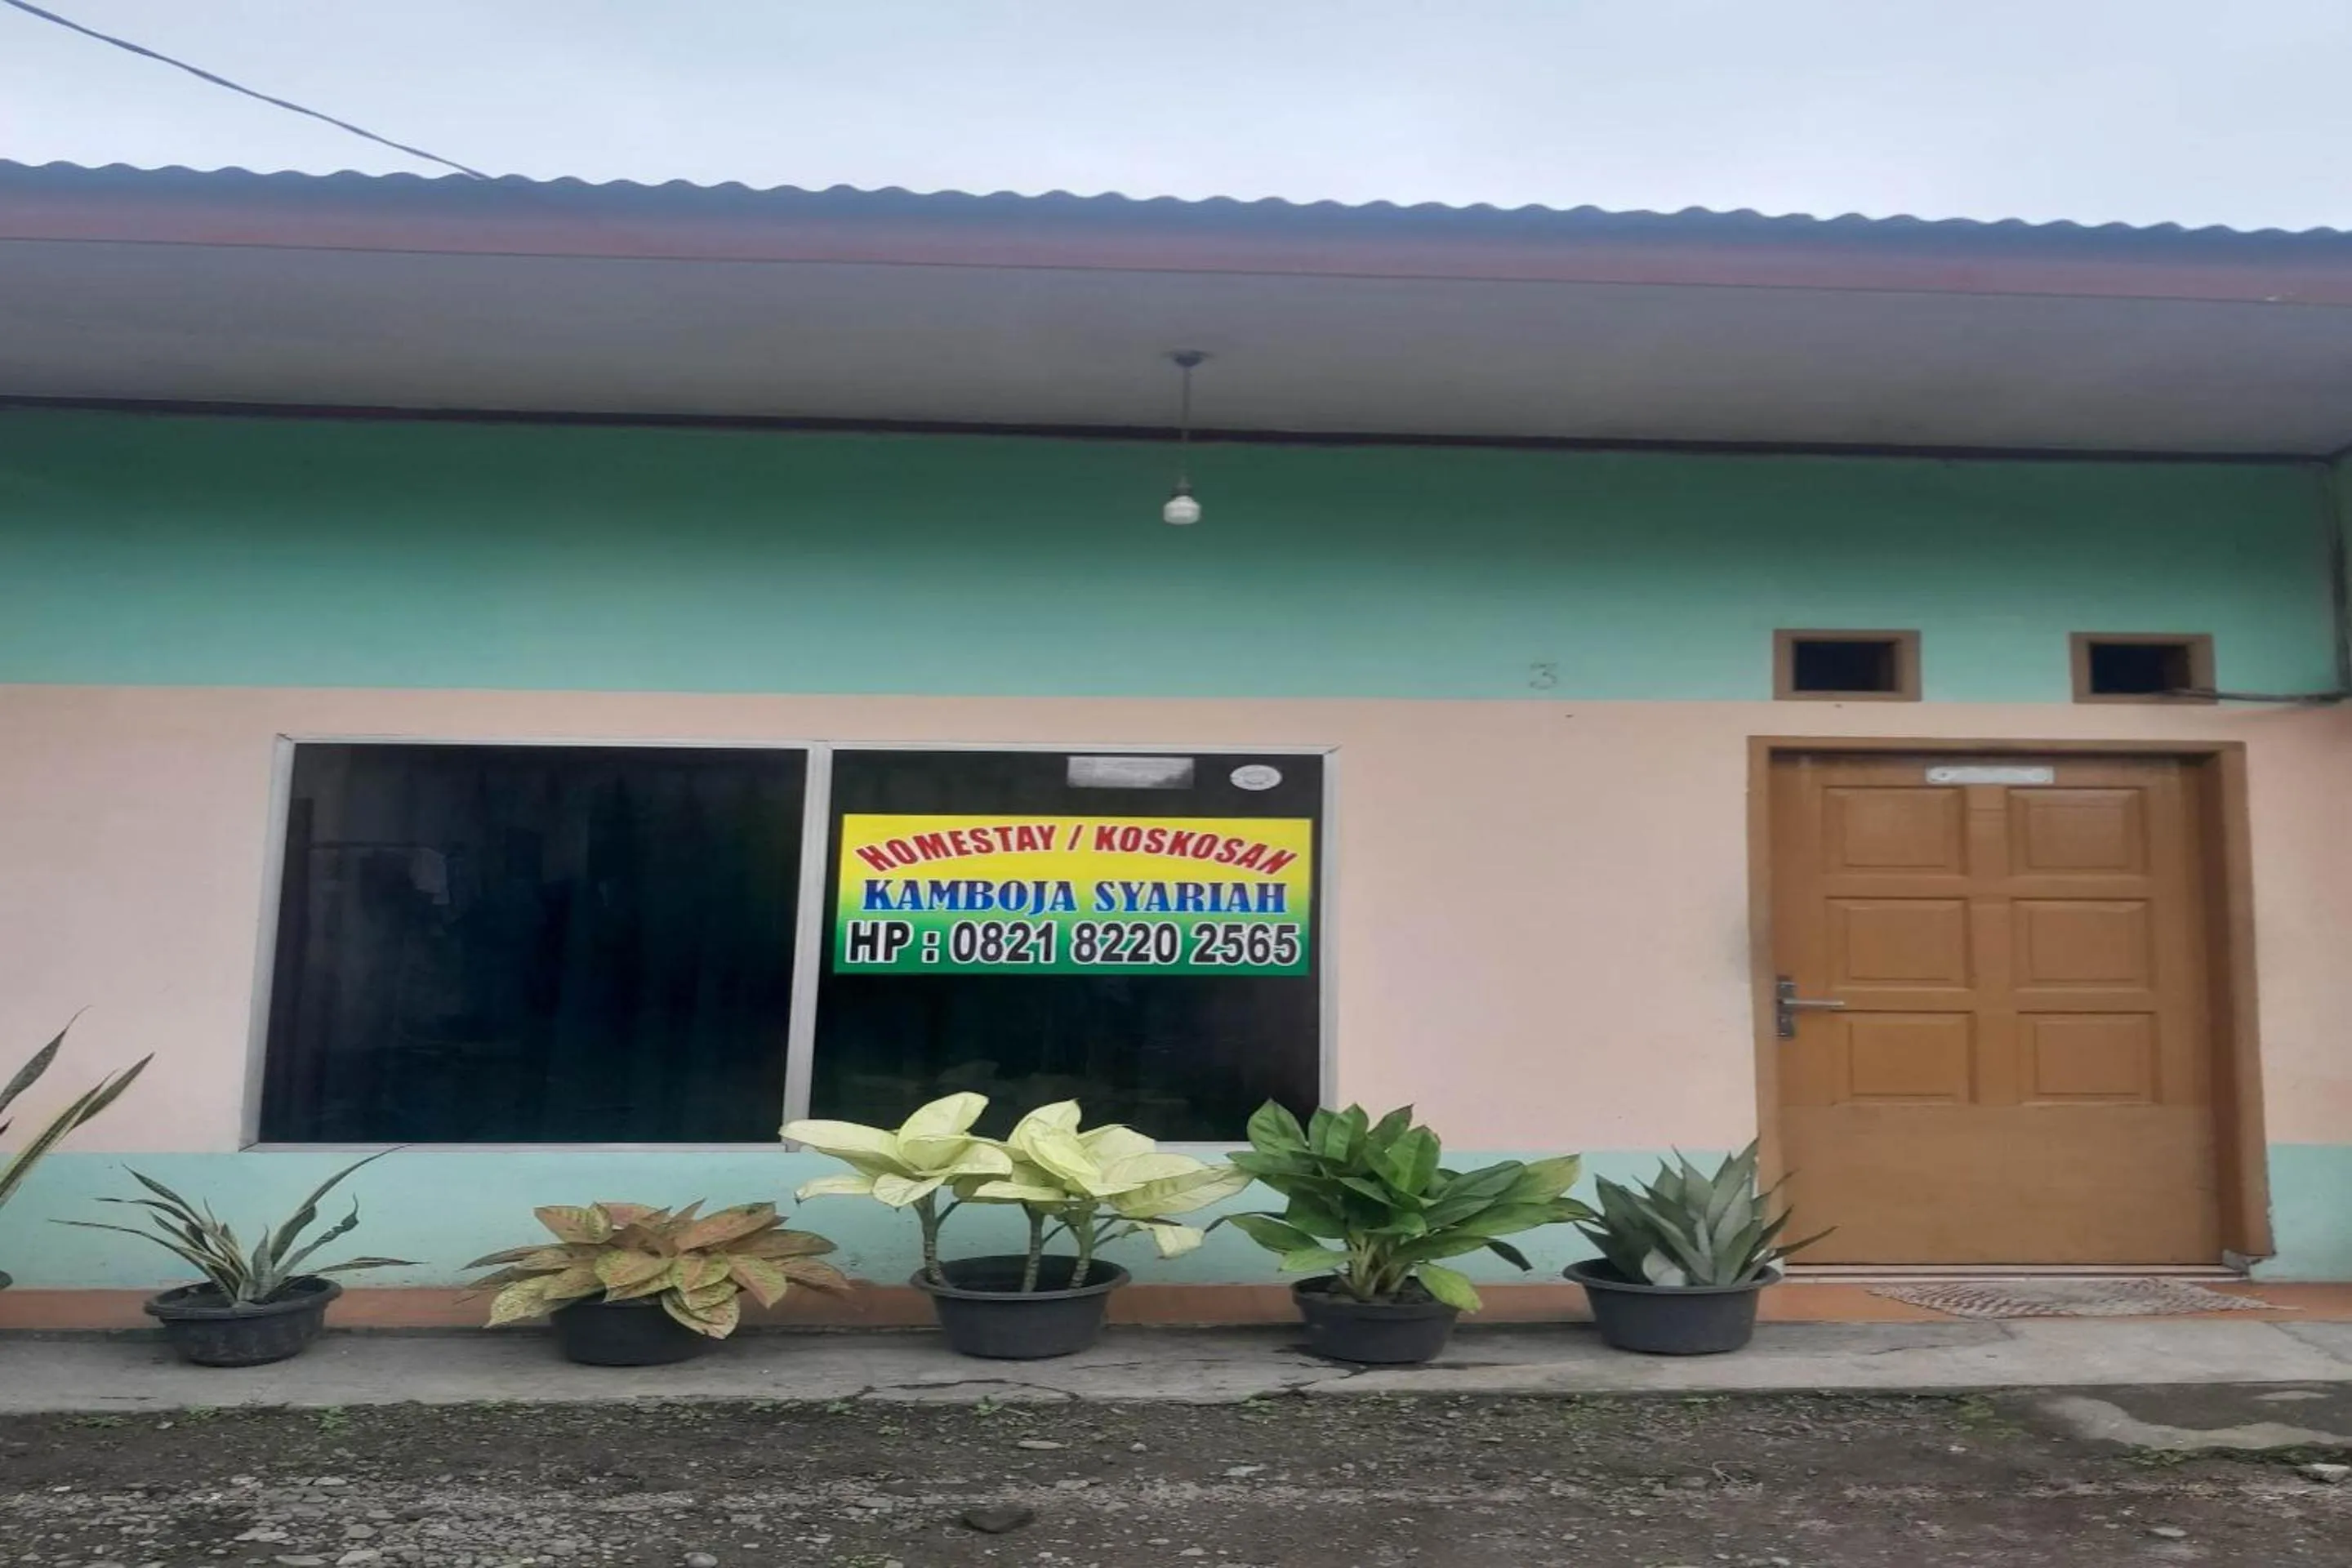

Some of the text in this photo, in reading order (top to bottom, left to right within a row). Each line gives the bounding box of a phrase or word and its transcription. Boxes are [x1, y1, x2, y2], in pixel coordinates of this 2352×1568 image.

[856, 824, 1297, 875] HOMESTAY / KOSKOSAN
[862, 879, 1286, 915] KAMBOJA SYARIAH
[847, 920, 912, 964] HP
[951, 920, 1056, 964] 0821
[1070, 921, 1181, 964] 8220
[1190, 923, 1299, 965] 2565
